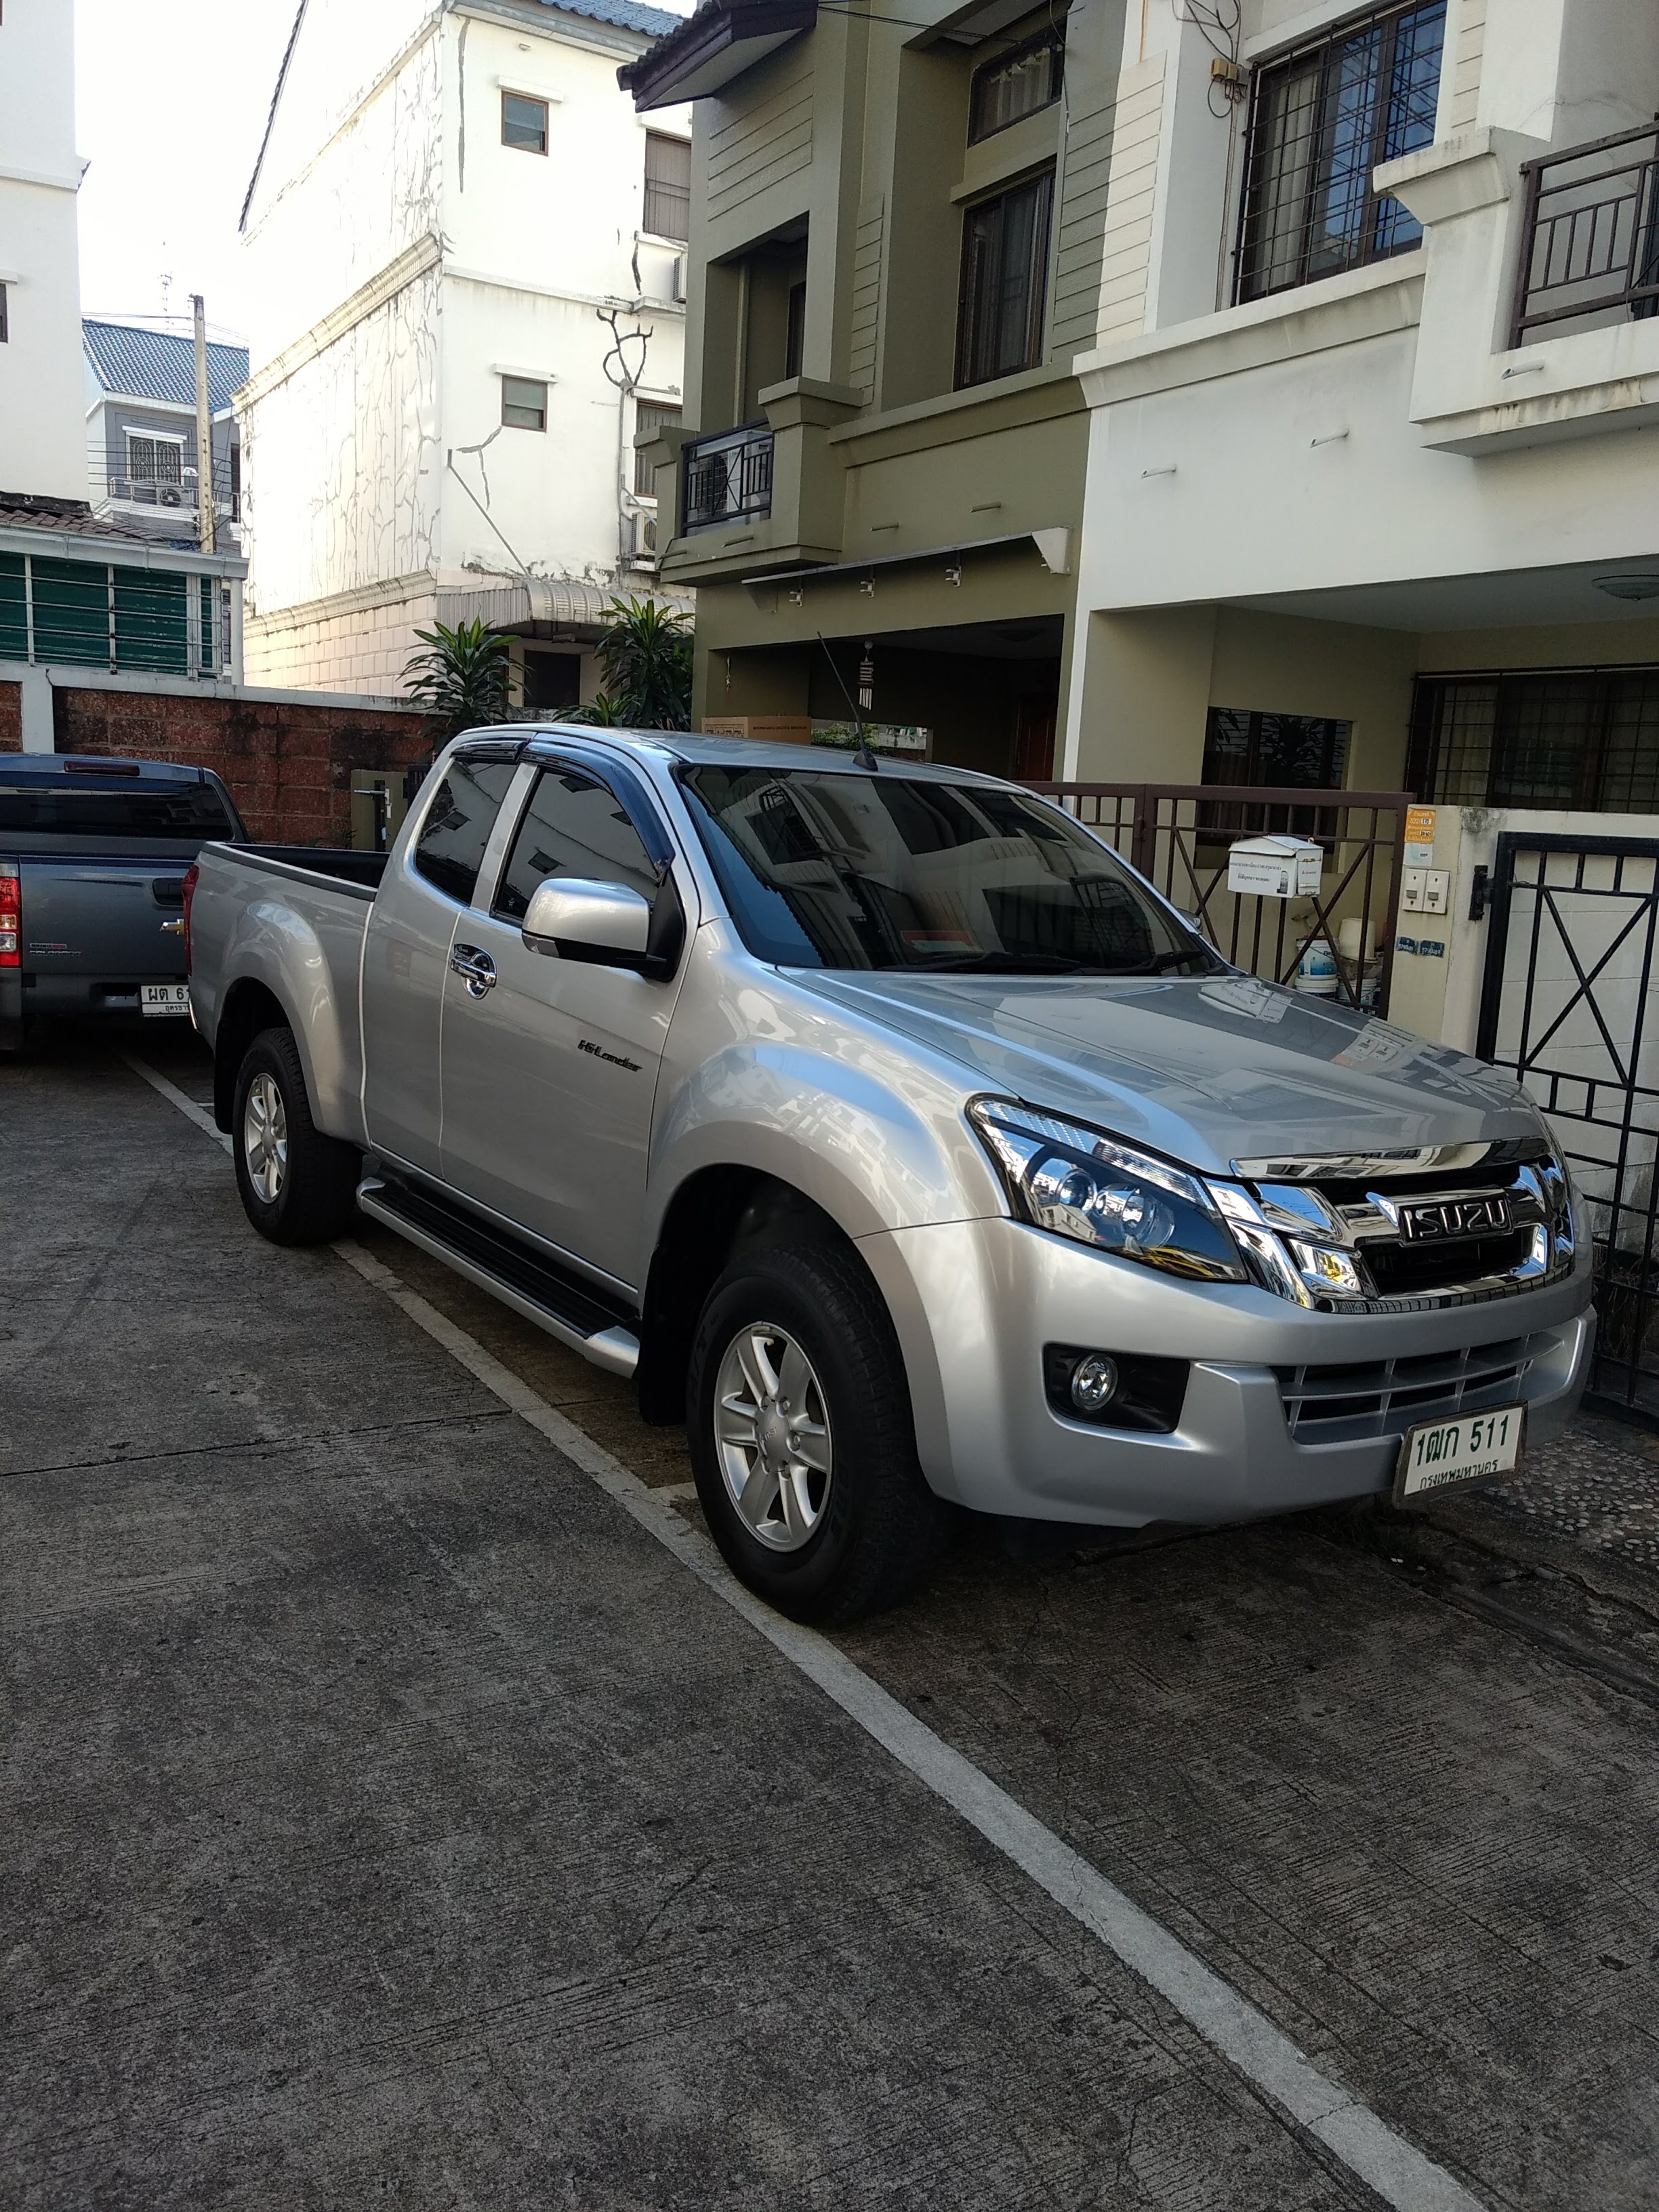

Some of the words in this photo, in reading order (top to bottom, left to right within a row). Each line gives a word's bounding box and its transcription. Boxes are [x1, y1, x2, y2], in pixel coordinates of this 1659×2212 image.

[176, 987, 190, 1000] 6
[1404, 1199, 1509, 1239] ISUZU
[1469, 1414, 1509, 1452] 511
